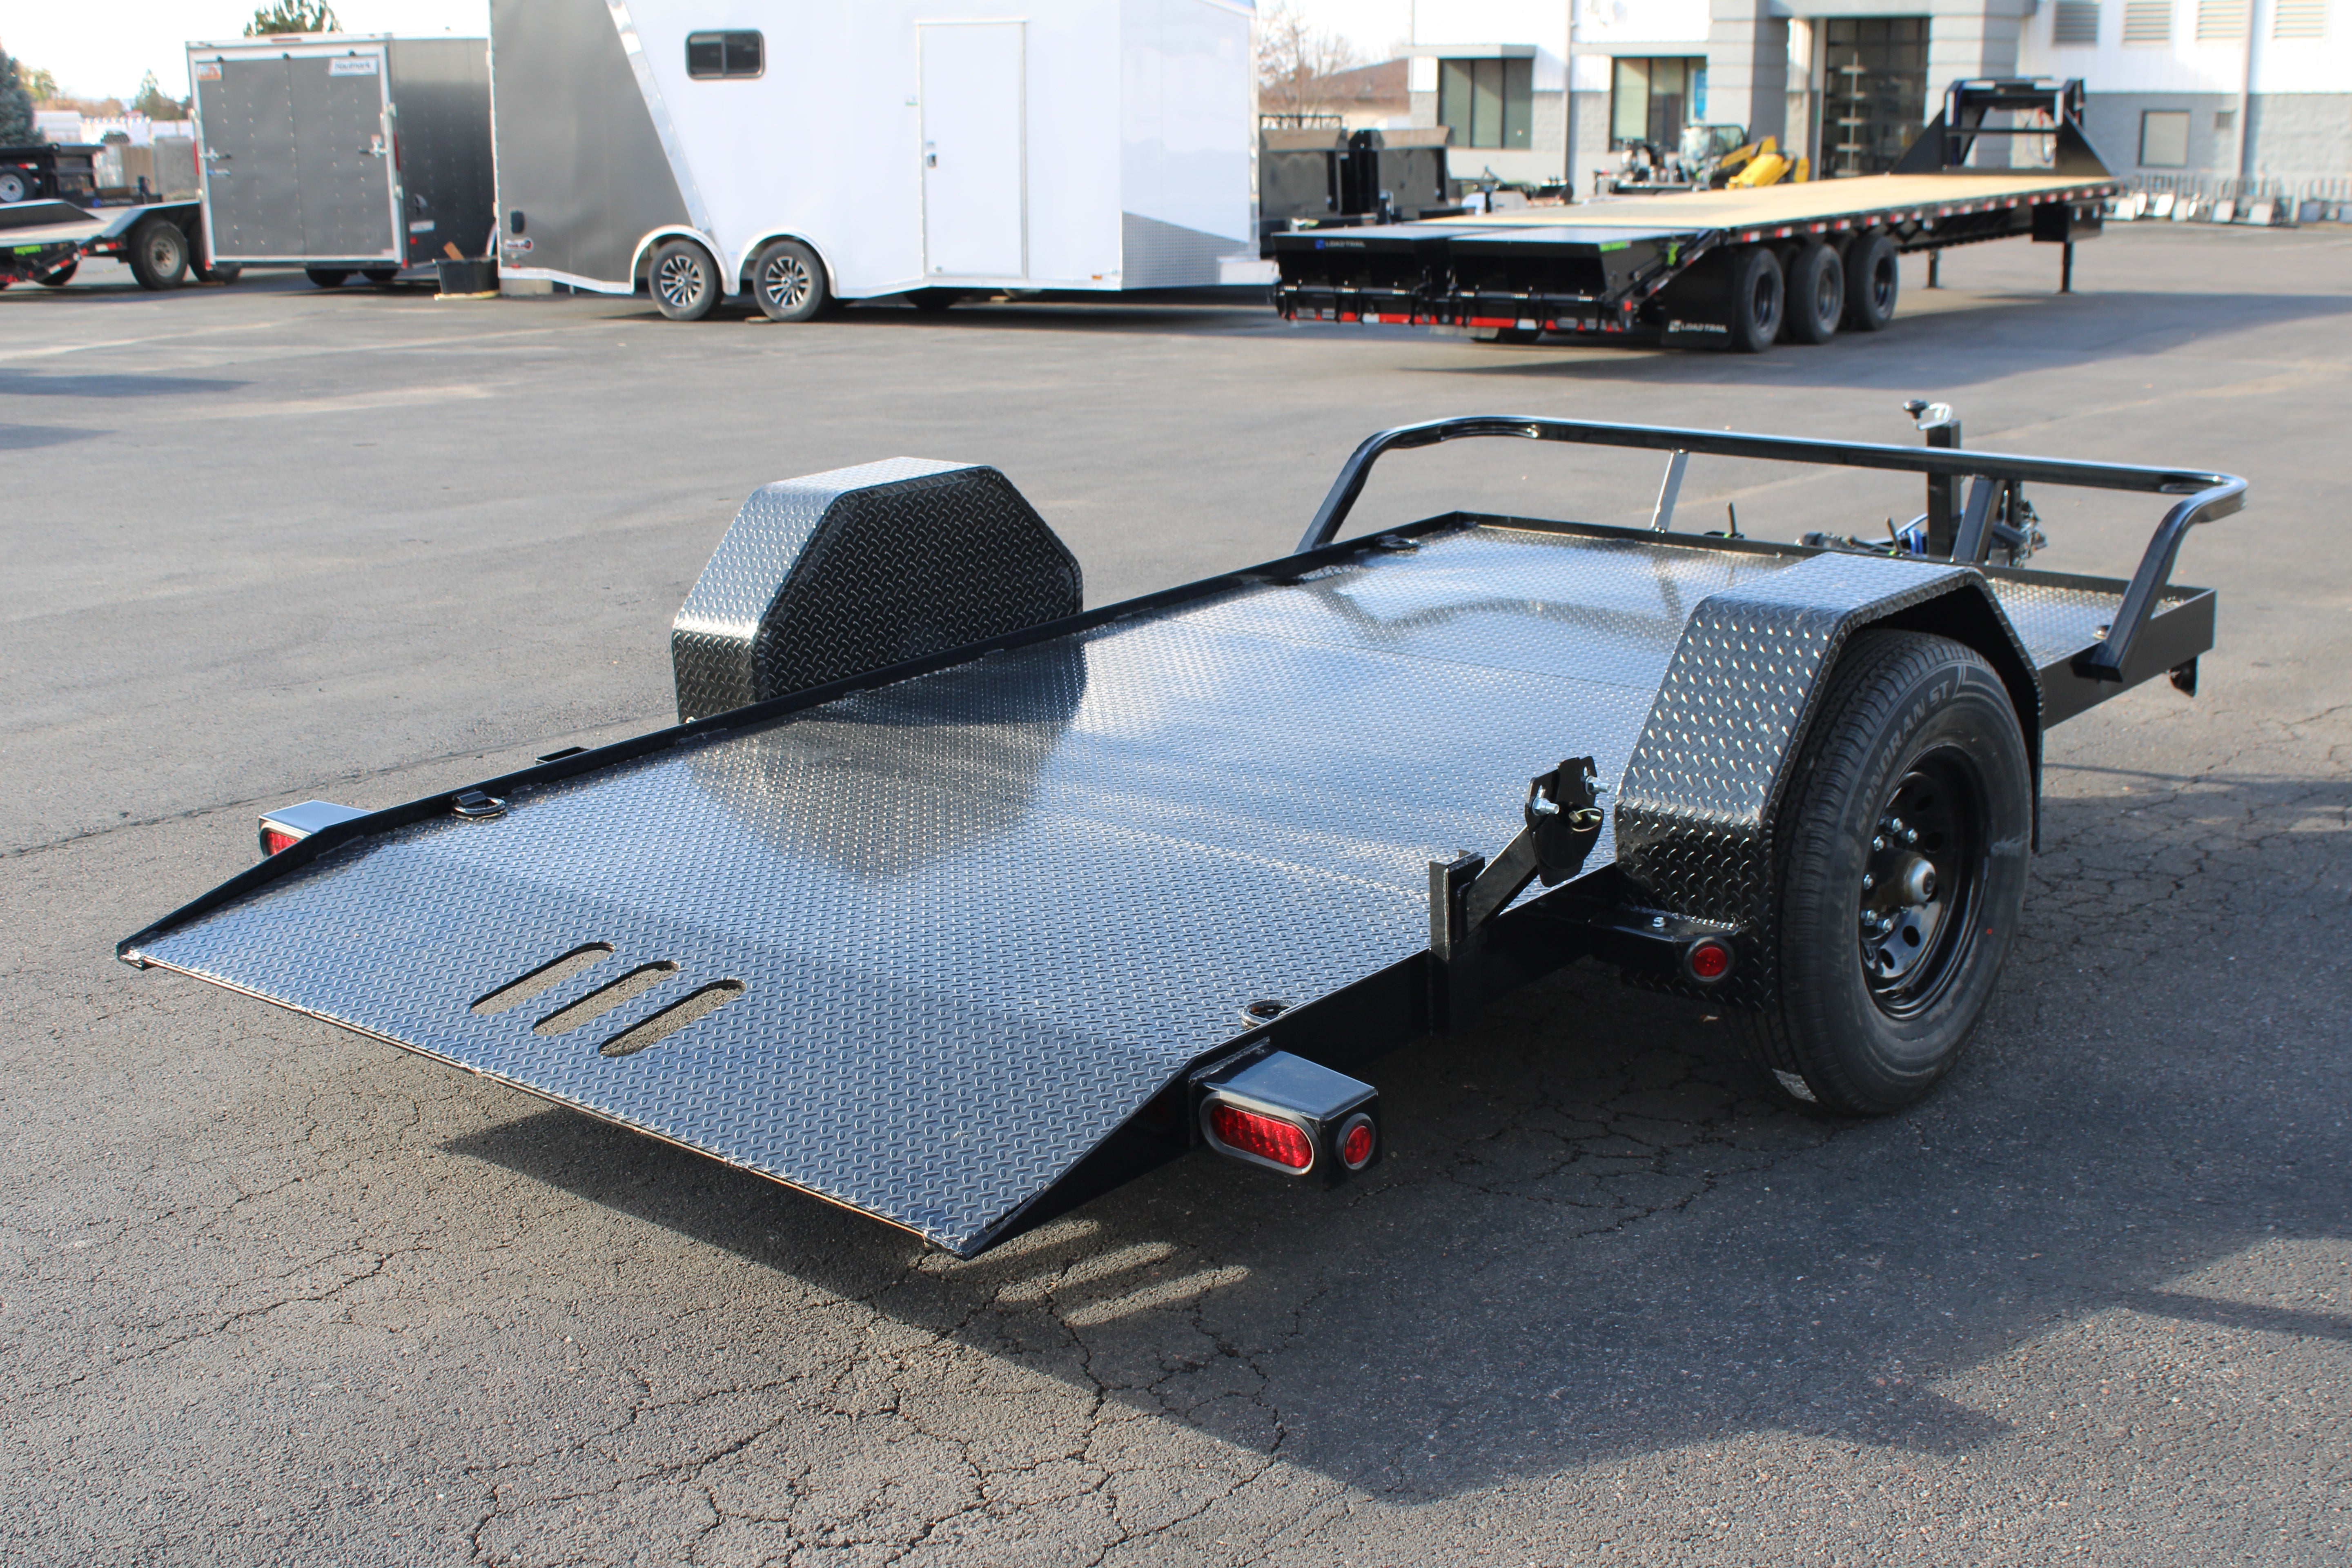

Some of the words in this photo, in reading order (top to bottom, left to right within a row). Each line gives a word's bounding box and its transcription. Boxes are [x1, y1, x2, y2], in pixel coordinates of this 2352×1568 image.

[1680, 322, 1704, 332] LOAD
[1704, 323, 1728, 333] TRAIL
[1928, 680, 1949, 708] ST
